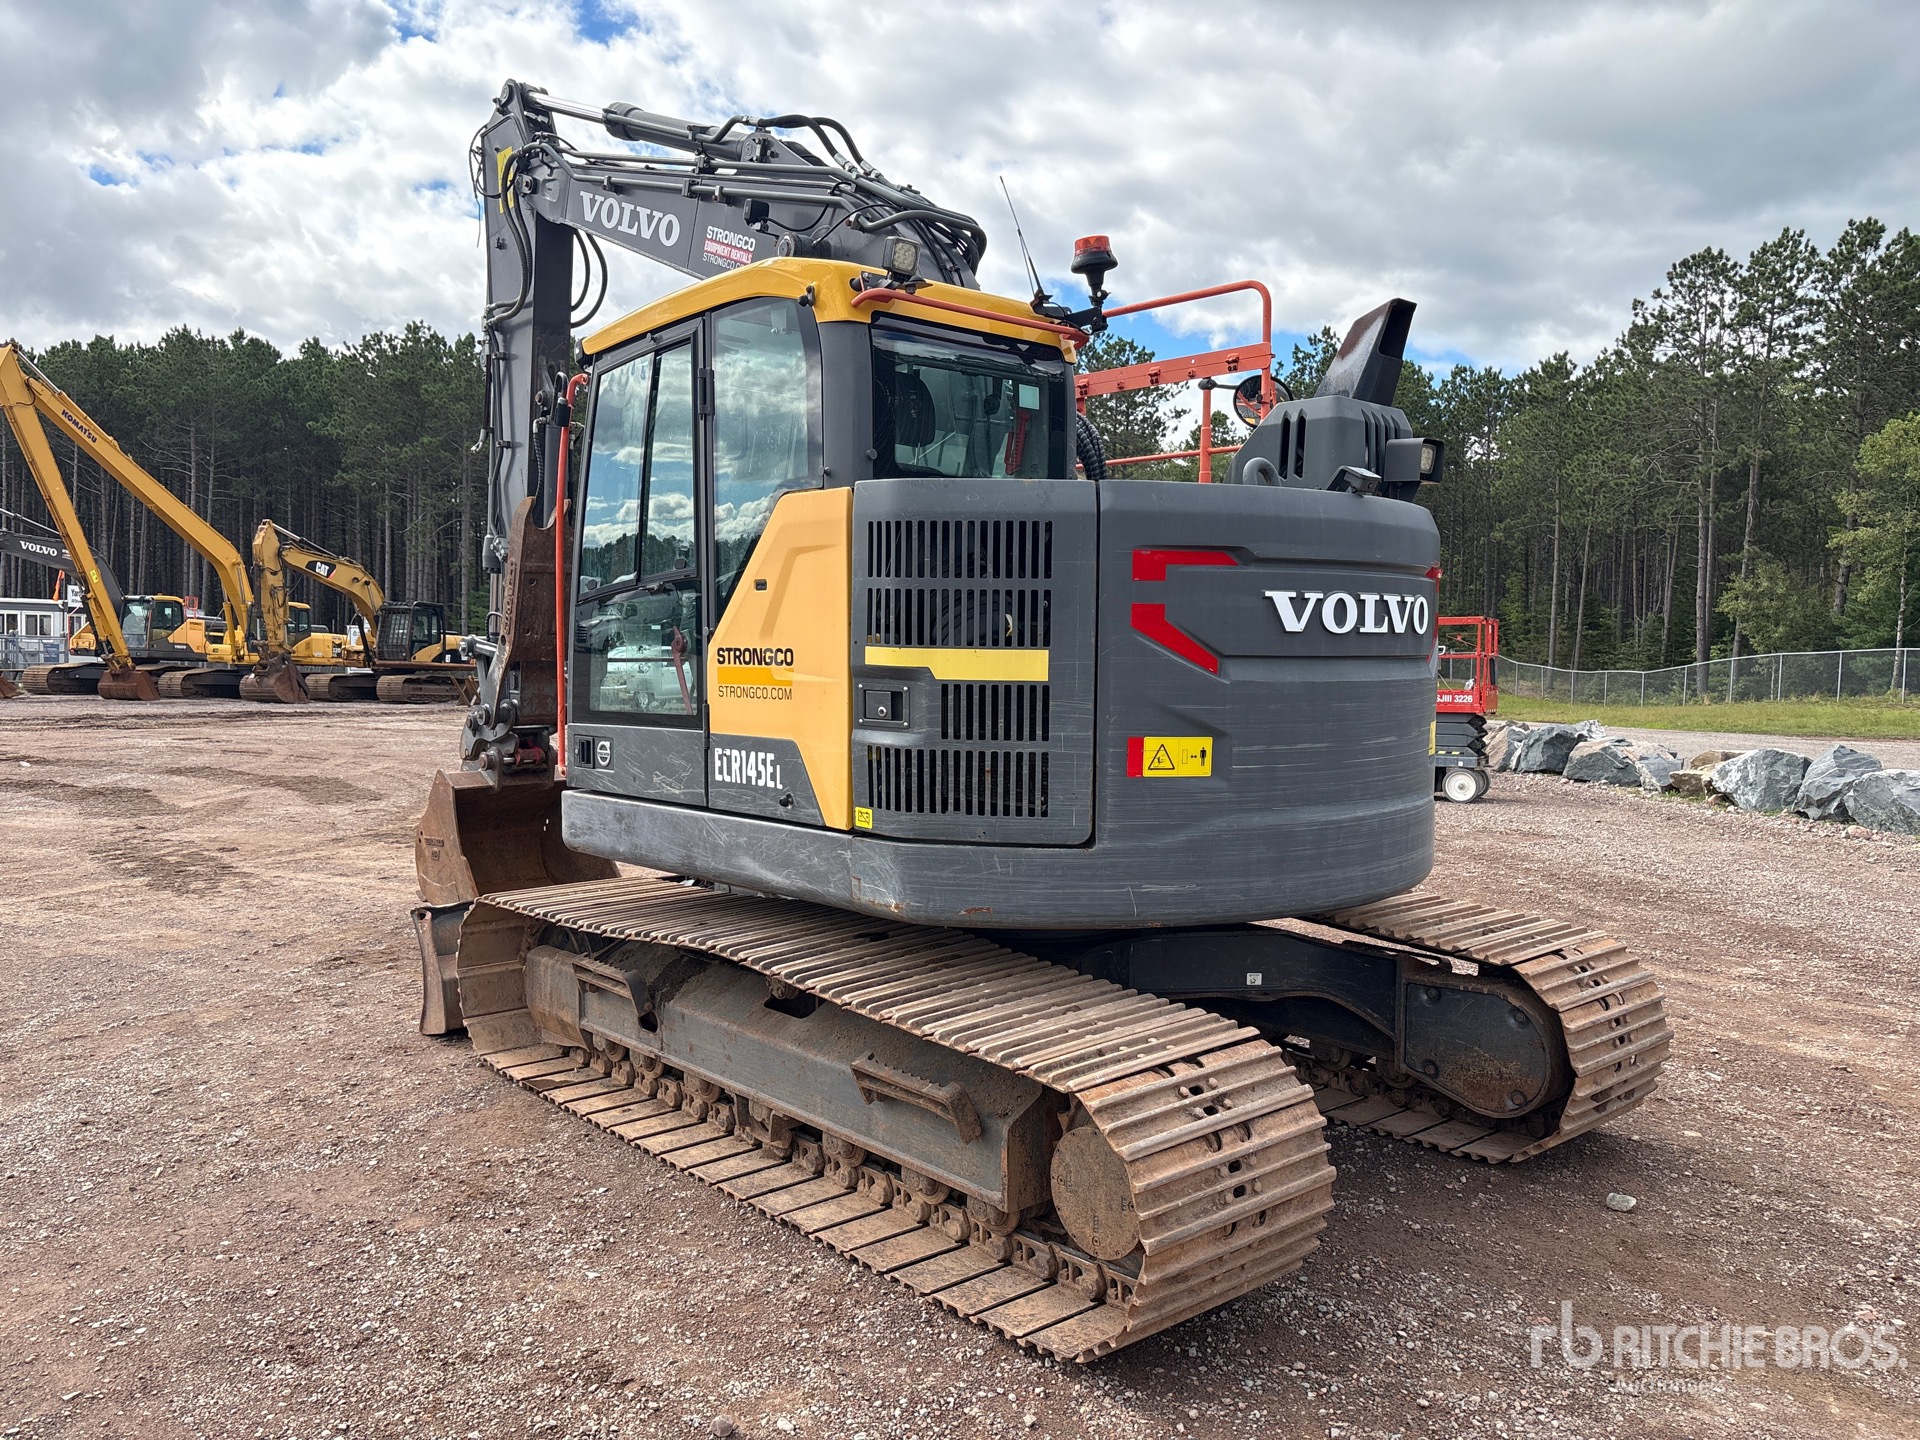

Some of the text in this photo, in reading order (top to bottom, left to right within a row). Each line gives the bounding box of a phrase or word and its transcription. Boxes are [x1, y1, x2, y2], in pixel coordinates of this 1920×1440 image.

[580, 191, 680, 247] VOLVO
[706, 225, 756, 252] STRONGCO
[704, 240, 753, 264] EQUIPMENT RENTALS
[61, 409, 97, 443] KOMATSU
[19, 540, 58, 557] VOLVO
[315, 561, 330, 577] CAT
[1264, 590, 1429, 635] VOLVO
[717, 647, 794, 667] STRONGCO
[718, 685, 792, 701] STRONGCO.COM
[1454, 694, 1473, 703] 3226
